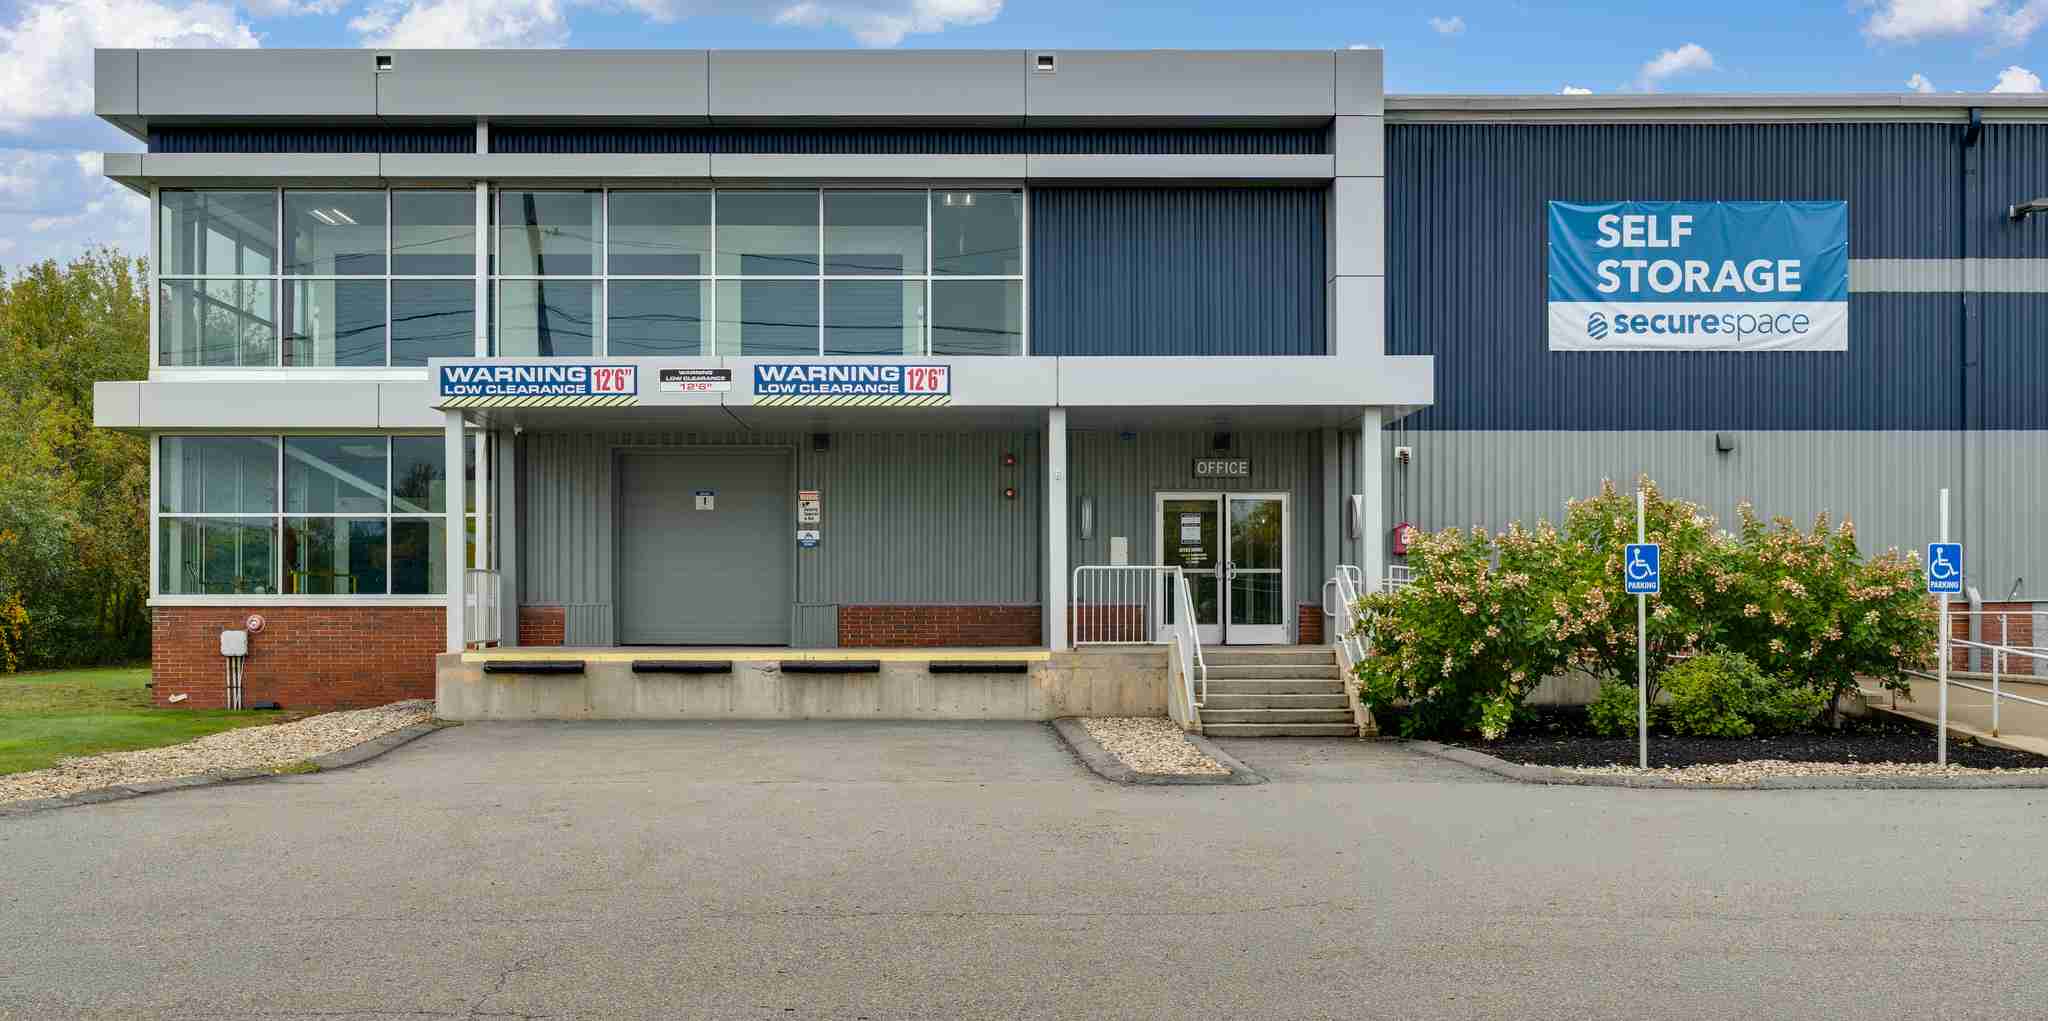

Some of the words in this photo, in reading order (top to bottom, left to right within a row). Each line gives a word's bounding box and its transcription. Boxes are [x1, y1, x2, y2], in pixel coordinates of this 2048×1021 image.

[1596, 214, 1693, 248] SELF
[1597, 259, 1802, 293] STORAGE
[1614, 312, 1810, 342] securespace
[444, 367, 587, 382] WARNING
[758, 366, 900, 382] WARNING
[445, 385, 483, 394] LOW
[486, 385, 586, 394] CLEARANCE
[759, 384, 796, 393] LOW
[799, 384, 899, 393] CLEARANCE
[1197, 461, 1248, 474] OFFICE
[1930, 581, 1959, 589] PARKING
